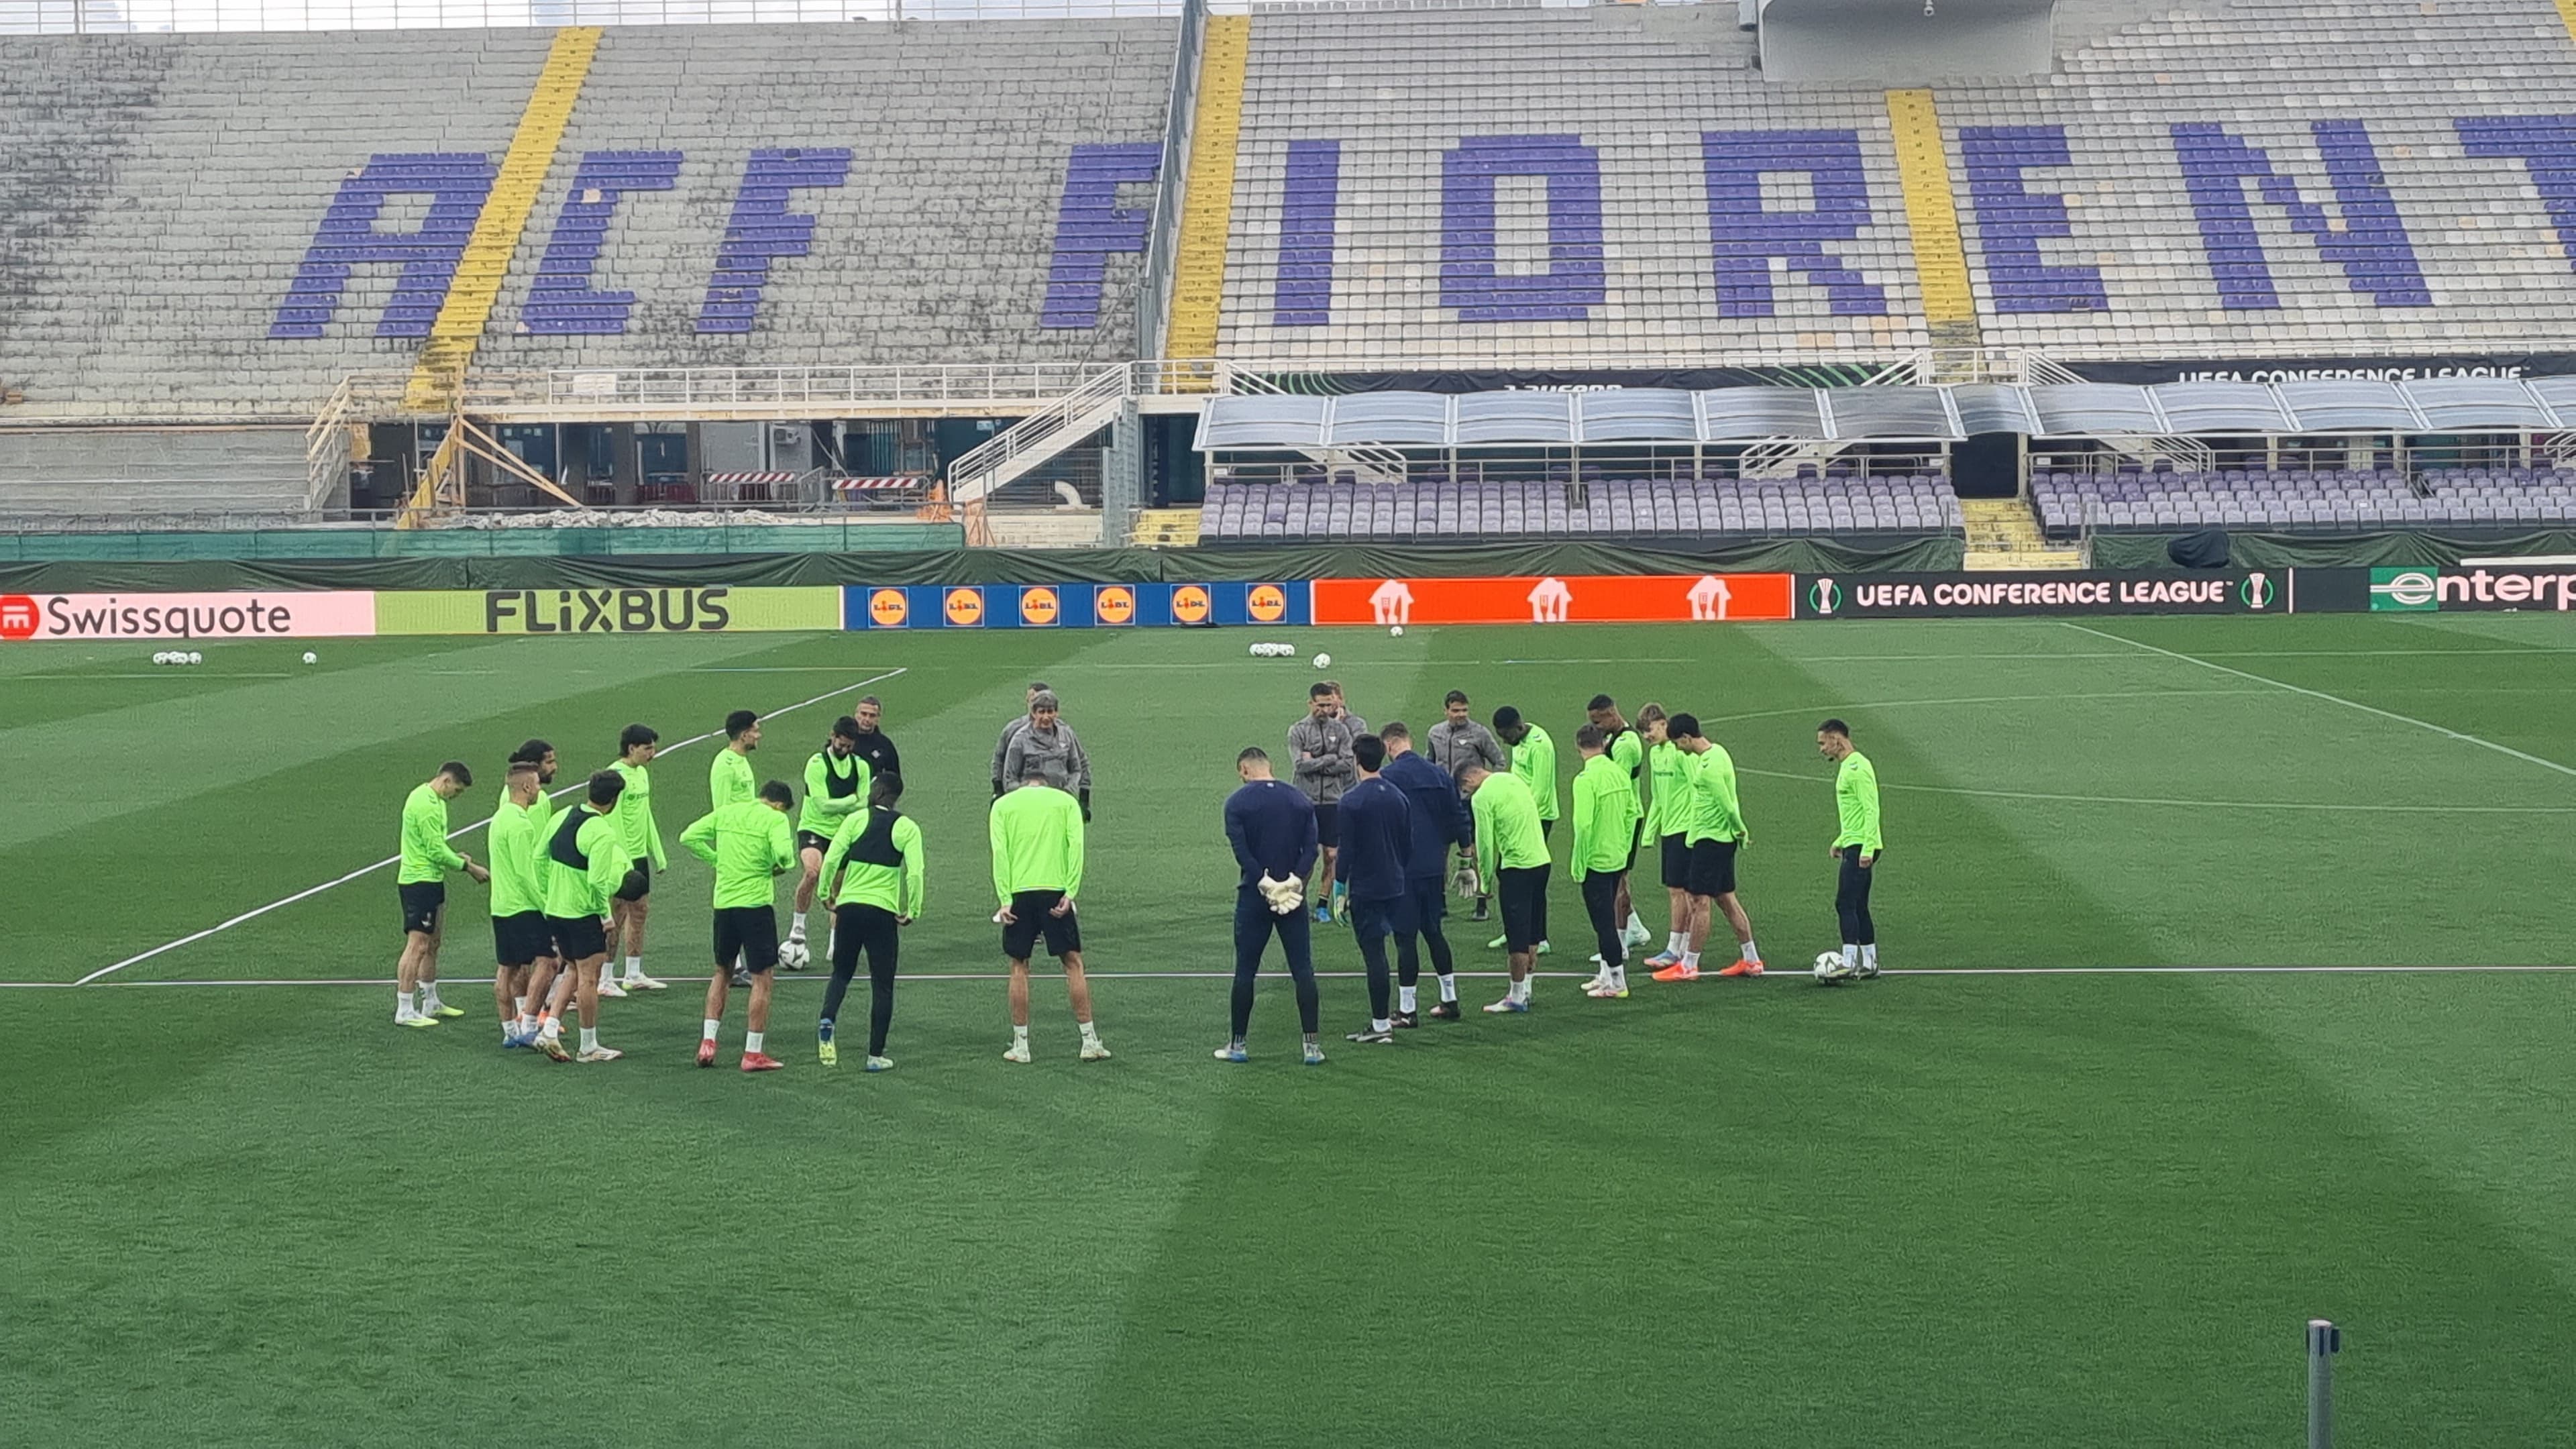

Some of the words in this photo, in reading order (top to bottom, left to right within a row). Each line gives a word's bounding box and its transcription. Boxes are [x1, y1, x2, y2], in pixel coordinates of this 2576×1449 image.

[270, 148, 852, 337] ACF
[1857, 585, 1927, 606] UEFA
[1934, 582, 2111, 605] CONFERENCE
[47, 596, 291, 638] Swissquote
